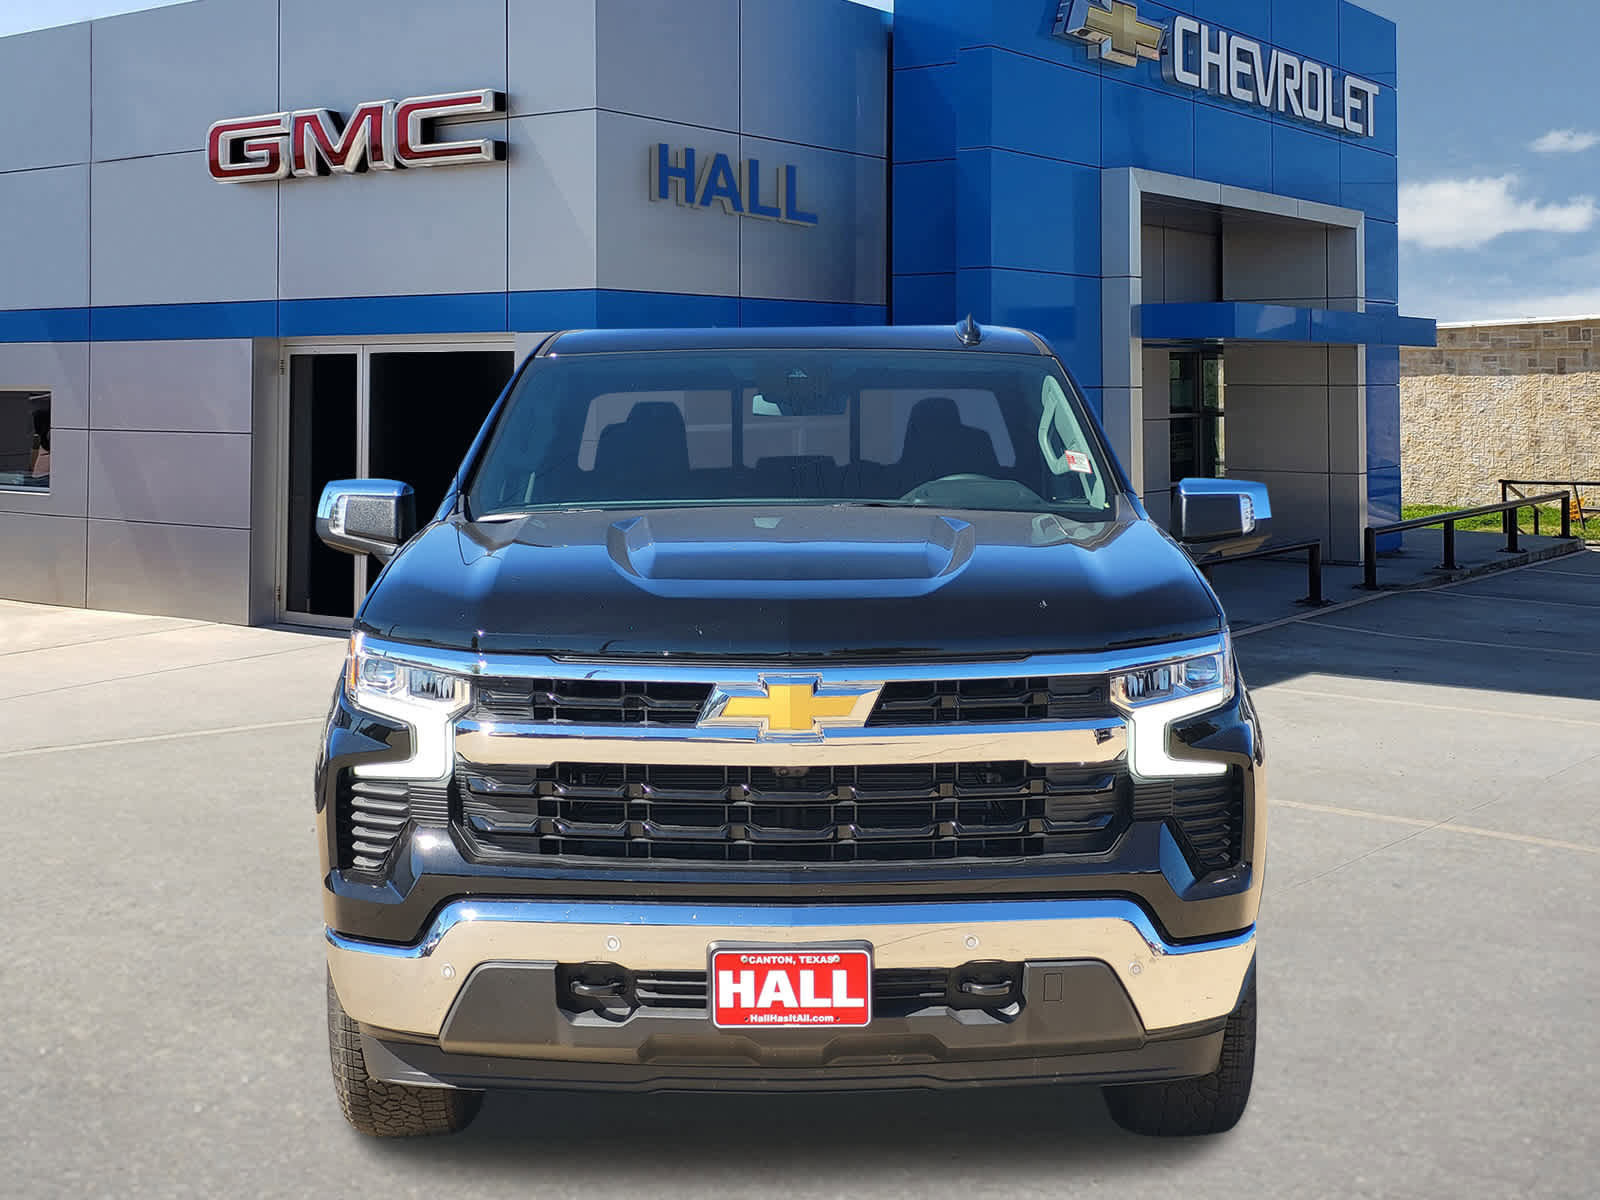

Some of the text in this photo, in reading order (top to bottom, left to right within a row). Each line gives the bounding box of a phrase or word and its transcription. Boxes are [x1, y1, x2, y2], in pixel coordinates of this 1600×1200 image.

[1174, 16, 1380, 137] CHEVROLET
[208, 88, 505, 184] GMC
[652, 143, 818, 225] HALL
[718, 969, 865, 1008] HALL
[748, 955, 834, 965] CANTON, TEXAS
[750, 1013, 834, 1023] HallHasItAll.com
